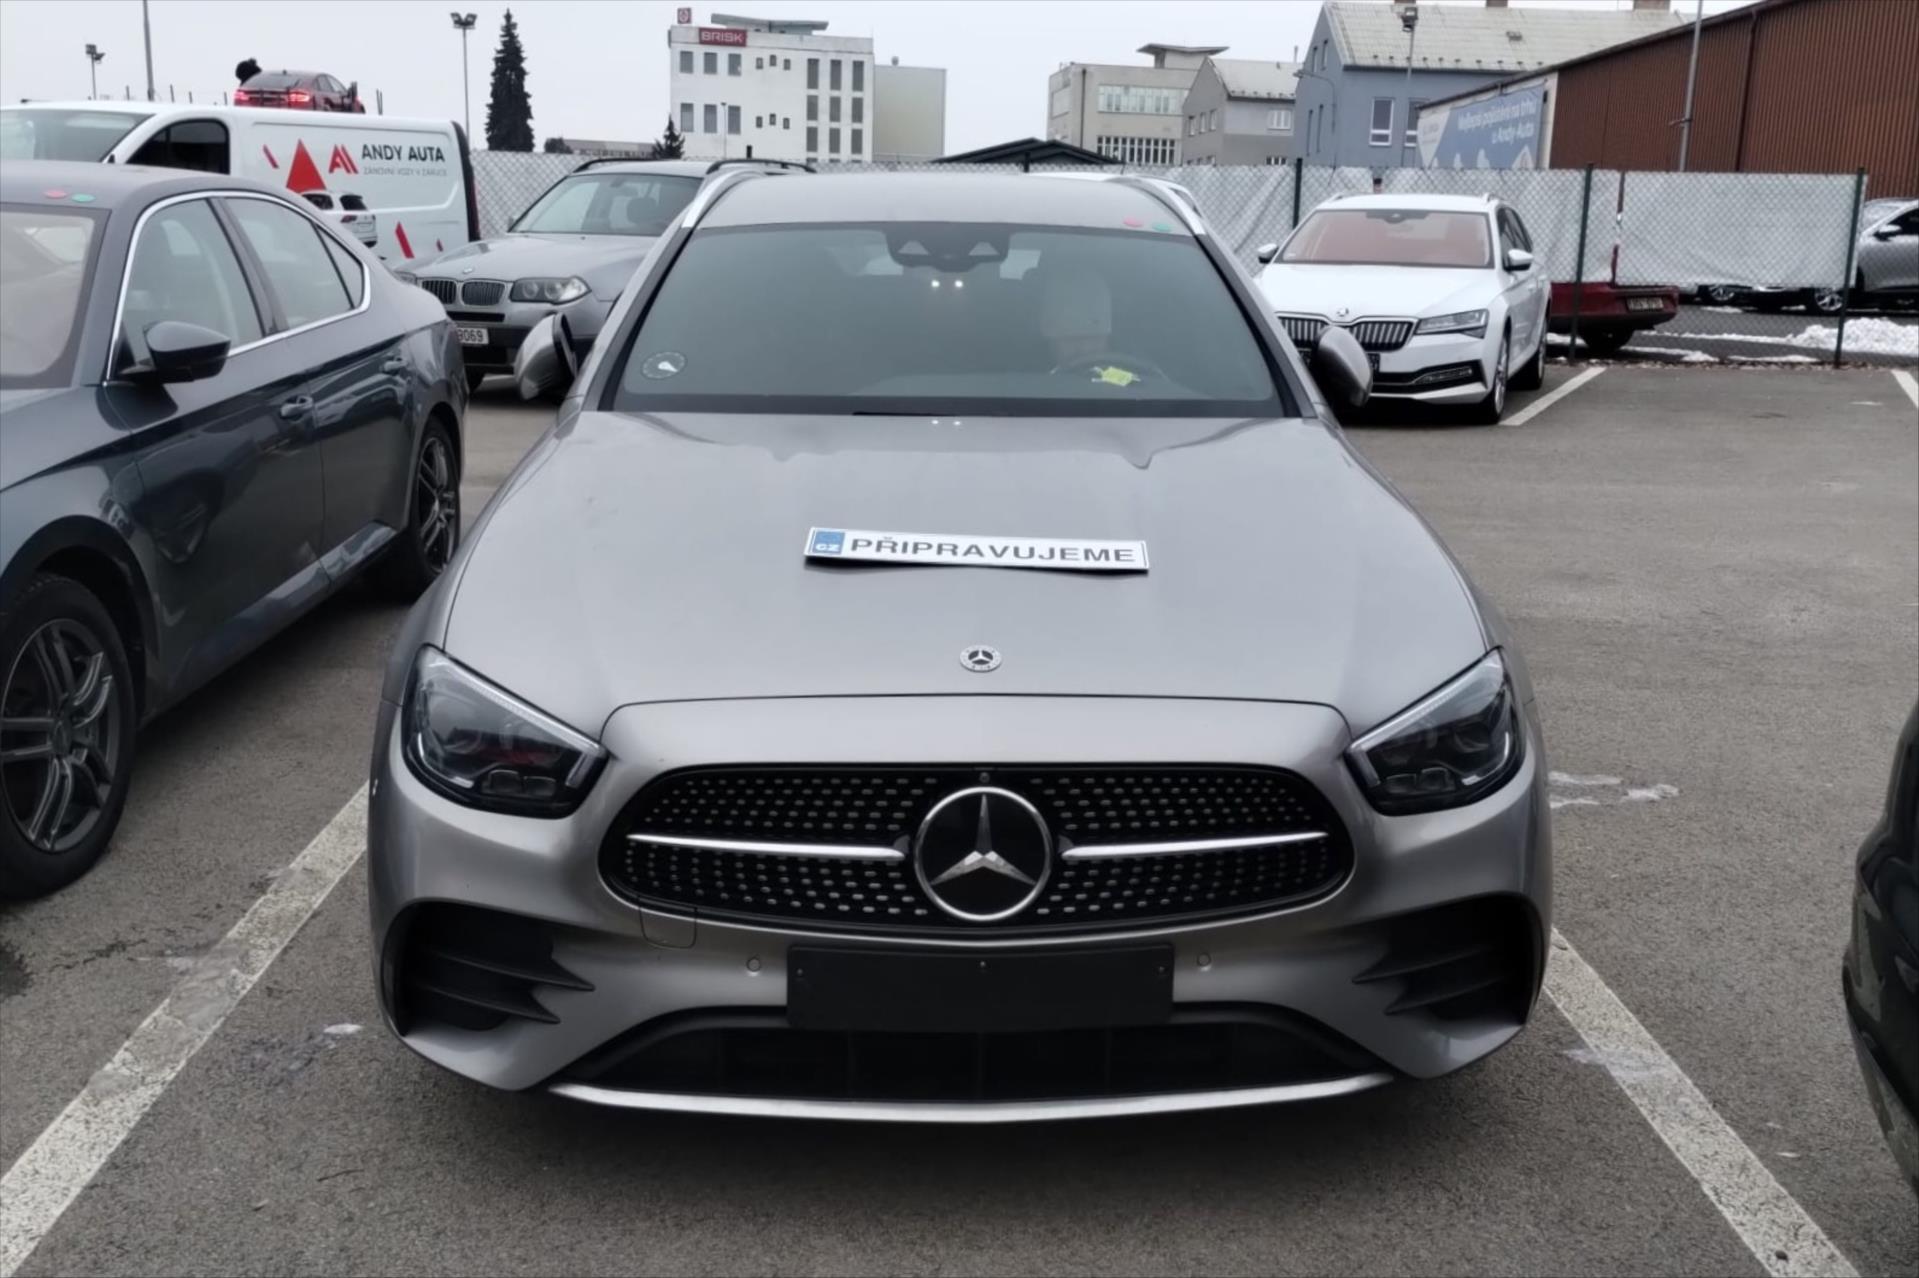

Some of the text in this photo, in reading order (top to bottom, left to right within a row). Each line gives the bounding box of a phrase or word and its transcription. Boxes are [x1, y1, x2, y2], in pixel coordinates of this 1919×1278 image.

[701, 30, 744, 43] BRISK
[362, 143, 446, 163] ANDY AUTA
[815, 536, 1136, 562] CZ PŘIPRAVUJEME
